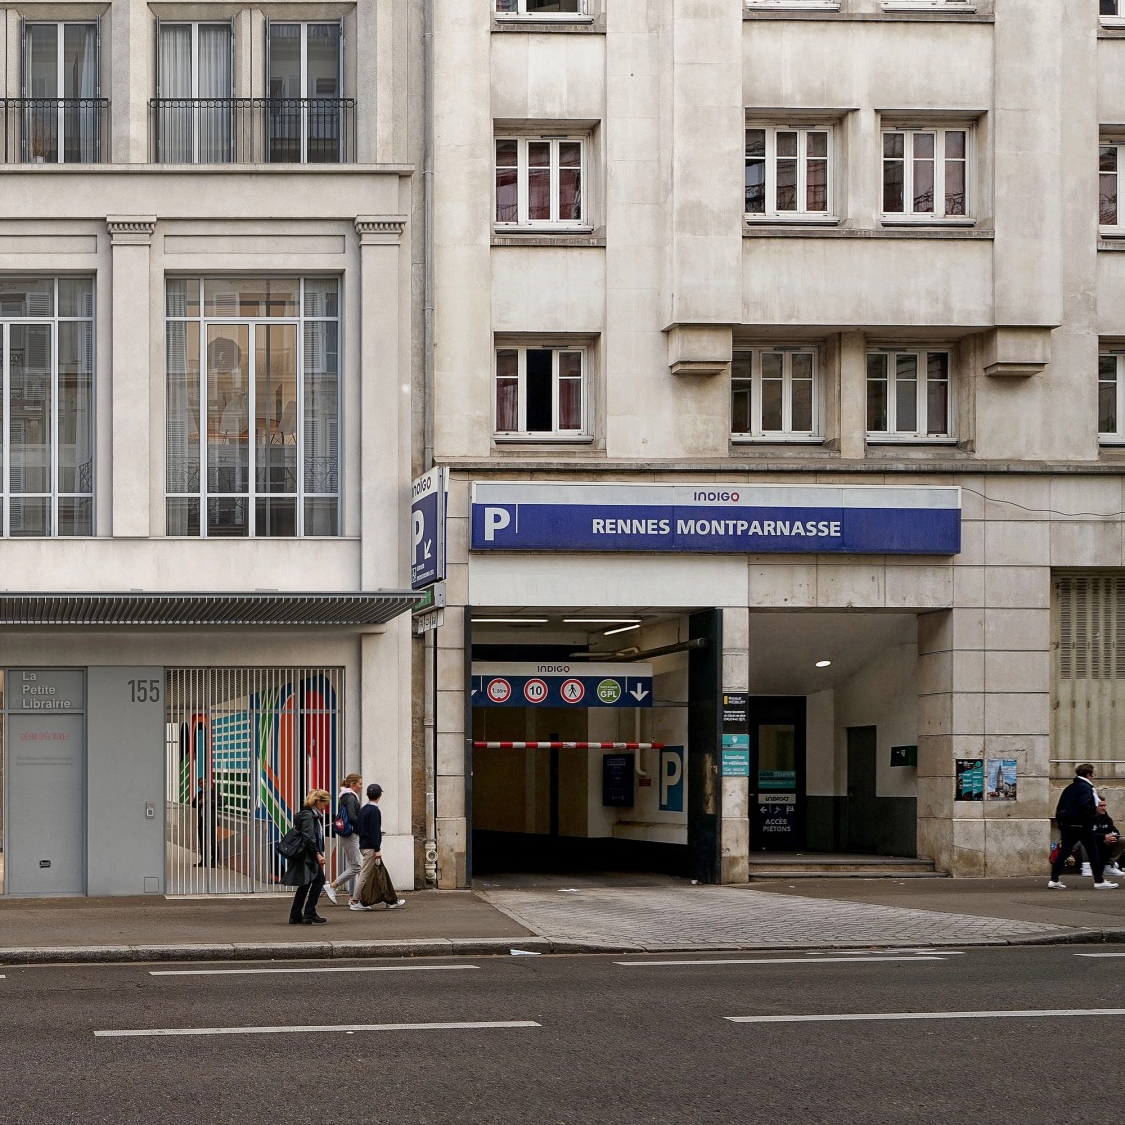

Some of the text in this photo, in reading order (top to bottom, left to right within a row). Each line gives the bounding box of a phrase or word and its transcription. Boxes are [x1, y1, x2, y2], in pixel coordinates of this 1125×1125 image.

[693, 491, 740, 502] INDIGO
[484, 507, 511, 541] P
[591, 518, 841, 537] RENNES MONTPARNASSE
[537, 665, 570, 673] INDIGO
[22, 671, 37, 681] La
[22, 684, 56, 695] Petite
[127, 679, 160, 703] 155
[529, 685, 542, 696] 10
[600, 690, 618, 699] GPL
[22, 698, 71, 709] Librairie
[661, 751, 682, 806] P
[765, 817, 788, 825] ACCÈS
